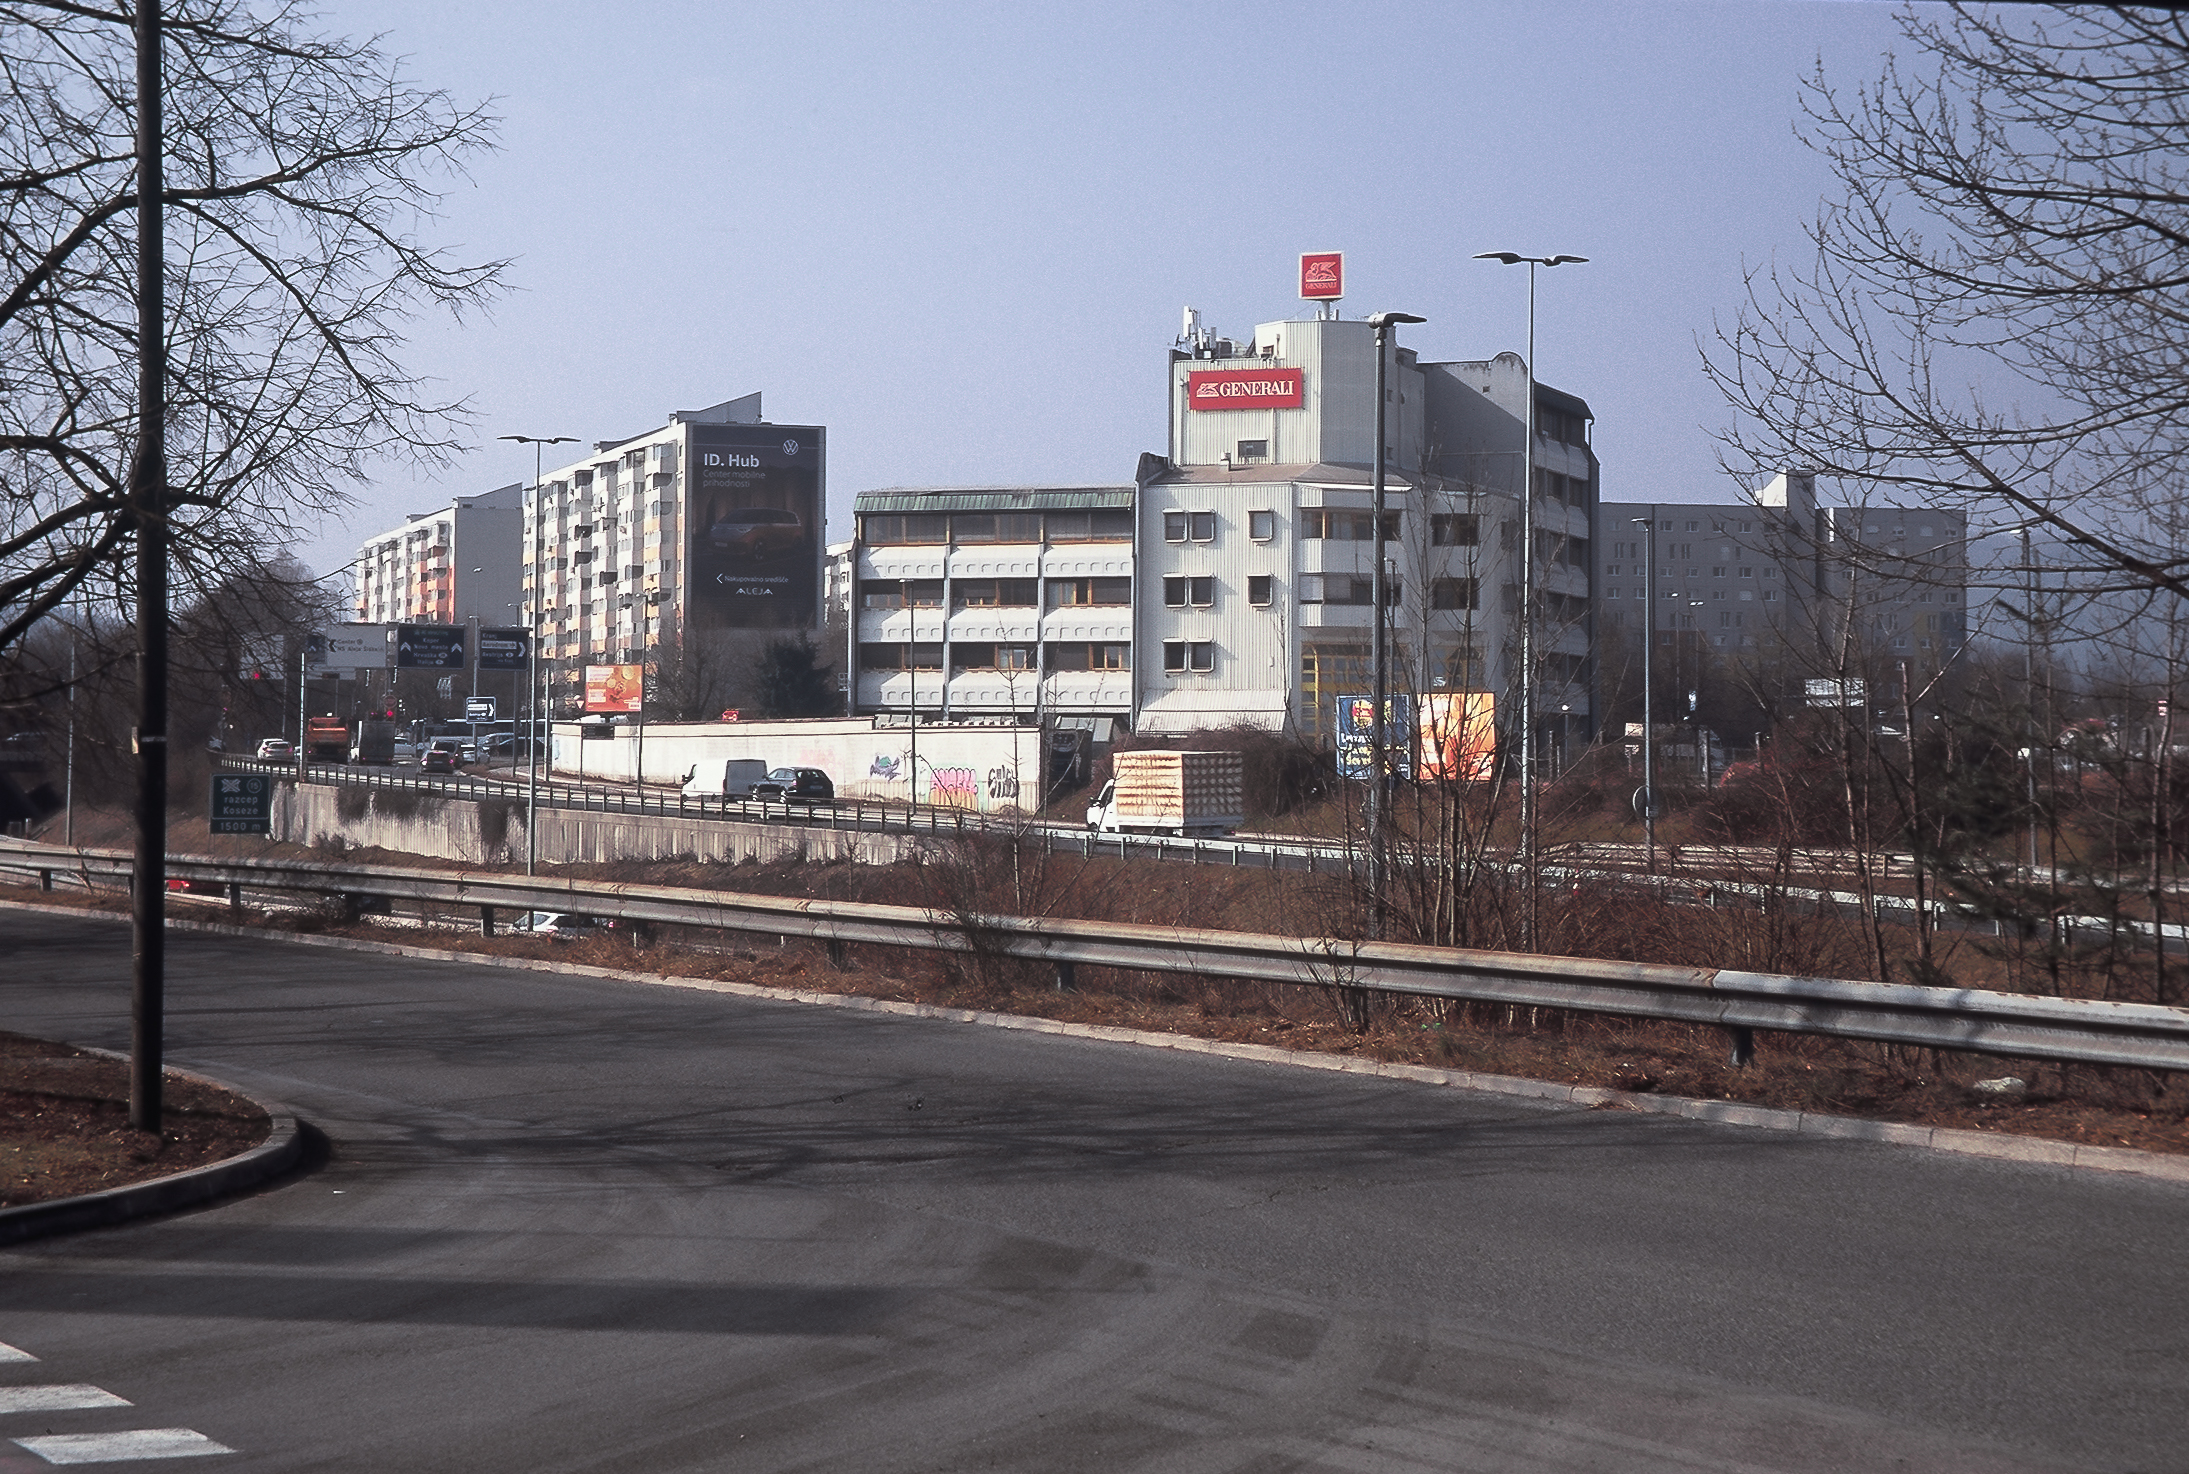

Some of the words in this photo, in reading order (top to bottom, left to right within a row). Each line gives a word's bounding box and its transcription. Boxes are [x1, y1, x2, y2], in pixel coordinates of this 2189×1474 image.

[1305, 282, 1338, 290] GENERALI
[1219, 380, 1294, 397] GENERALI
[704, 453, 725, 467] ID.
[728, 454, 760, 467] Hub
[703, 469, 730, 478] Center
[732, 471, 766, 479] mobilne
[703, 479, 750, 488] prihodnosti
[735, 588, 773, 596] ALEJA
[250, 782, 259, 790] 15
[224, 796, 258, 805] razcep
[223, 806, 259, 815] Koseze
[220, 821, 247, 831] 1500
[251, 823, 261, 831] m
